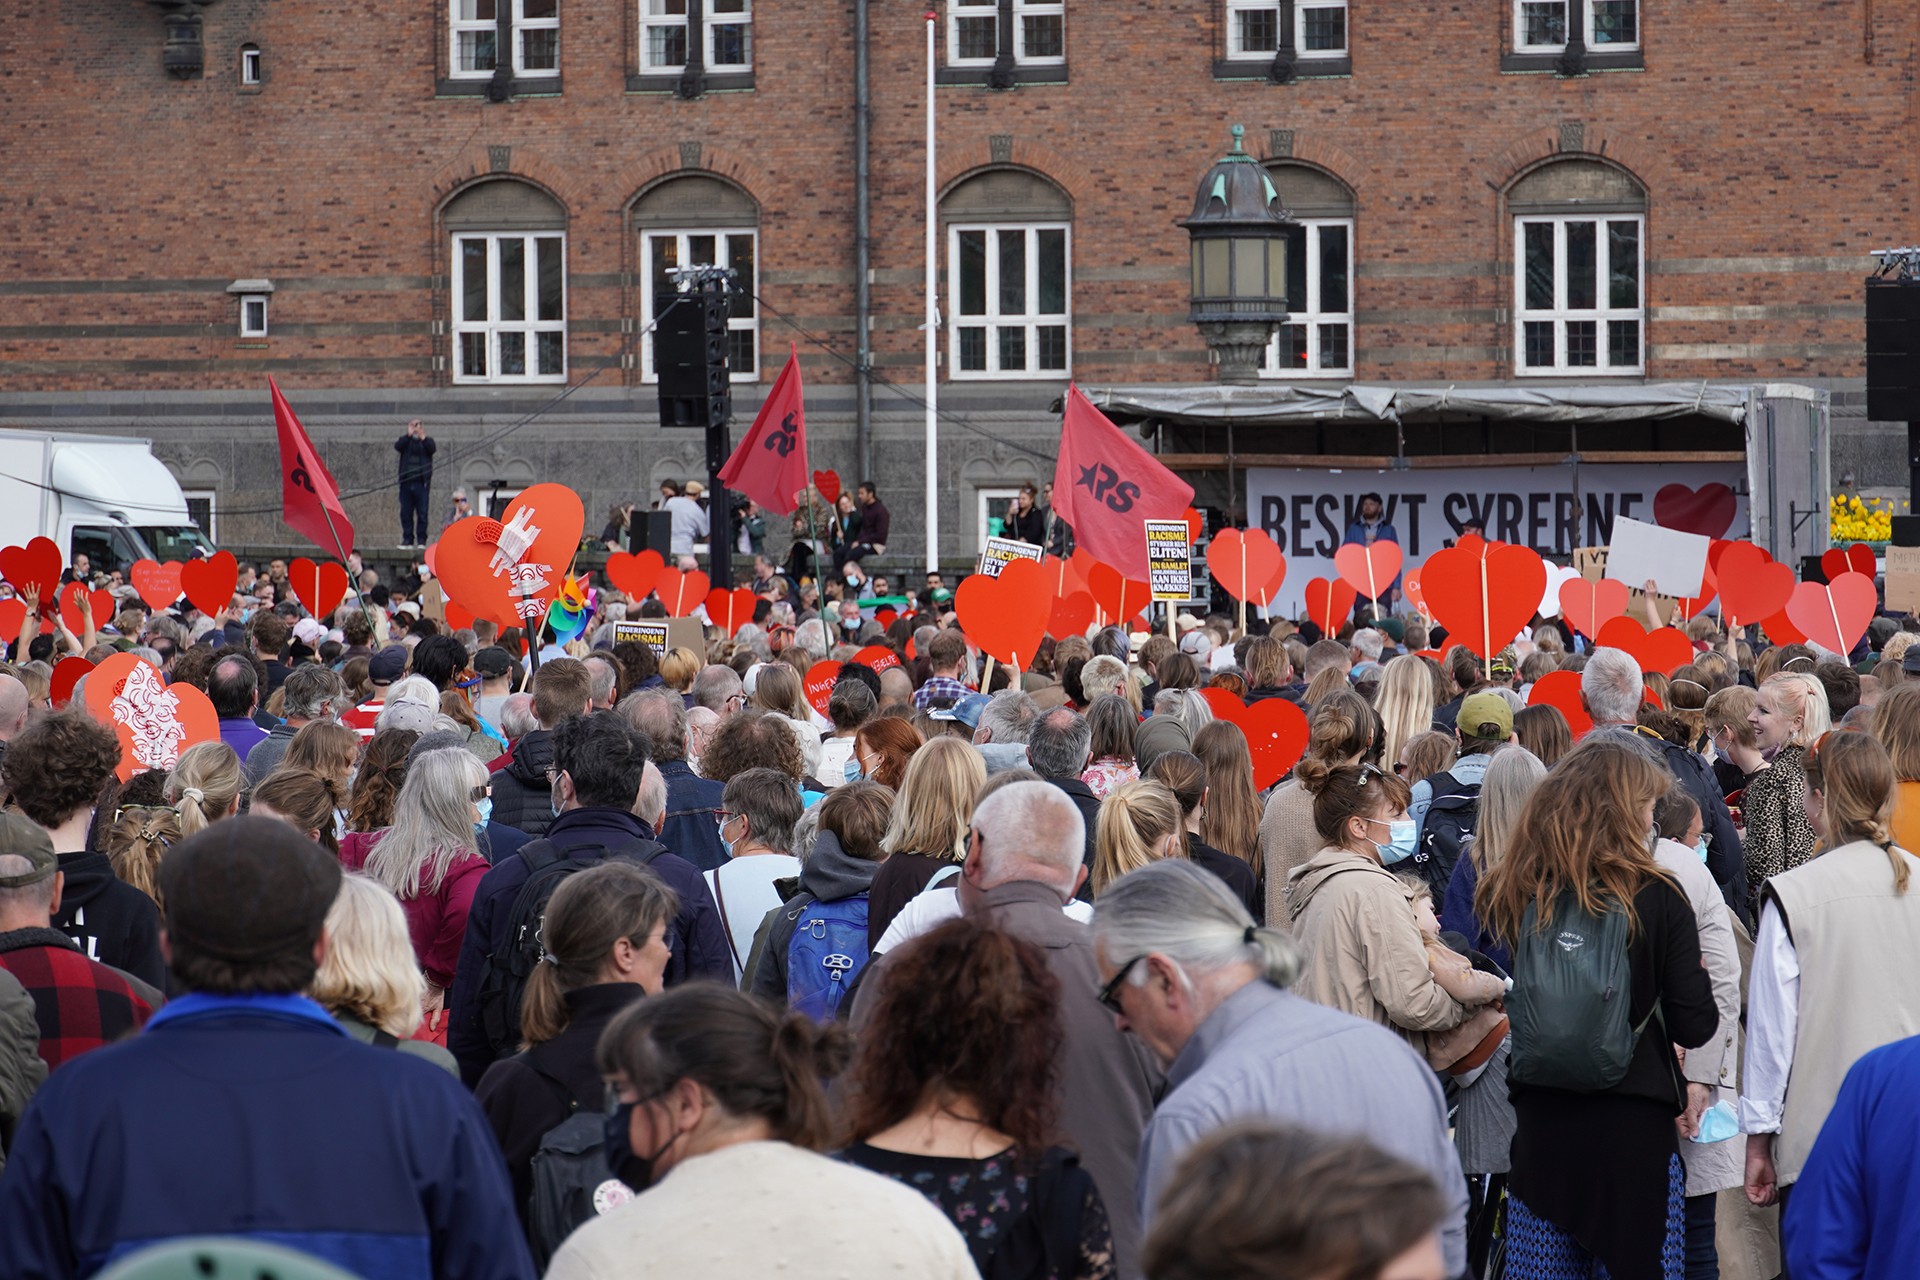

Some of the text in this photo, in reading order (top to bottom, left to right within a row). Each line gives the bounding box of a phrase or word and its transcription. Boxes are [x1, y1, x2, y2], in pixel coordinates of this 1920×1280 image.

[1149, 531, 1186, 541] RACISME
[988, 541, 1038, 557] REGERINGENS
[1150, 547, 1187, 559] ELITEN!
[1161, 562, 1188, 570] SAMLET
[1152, 574, 1189, 584] KAN IKKE
[617, 625, 665, 635] REGERINGENS
[617, 632, 664, 644] RACISME
